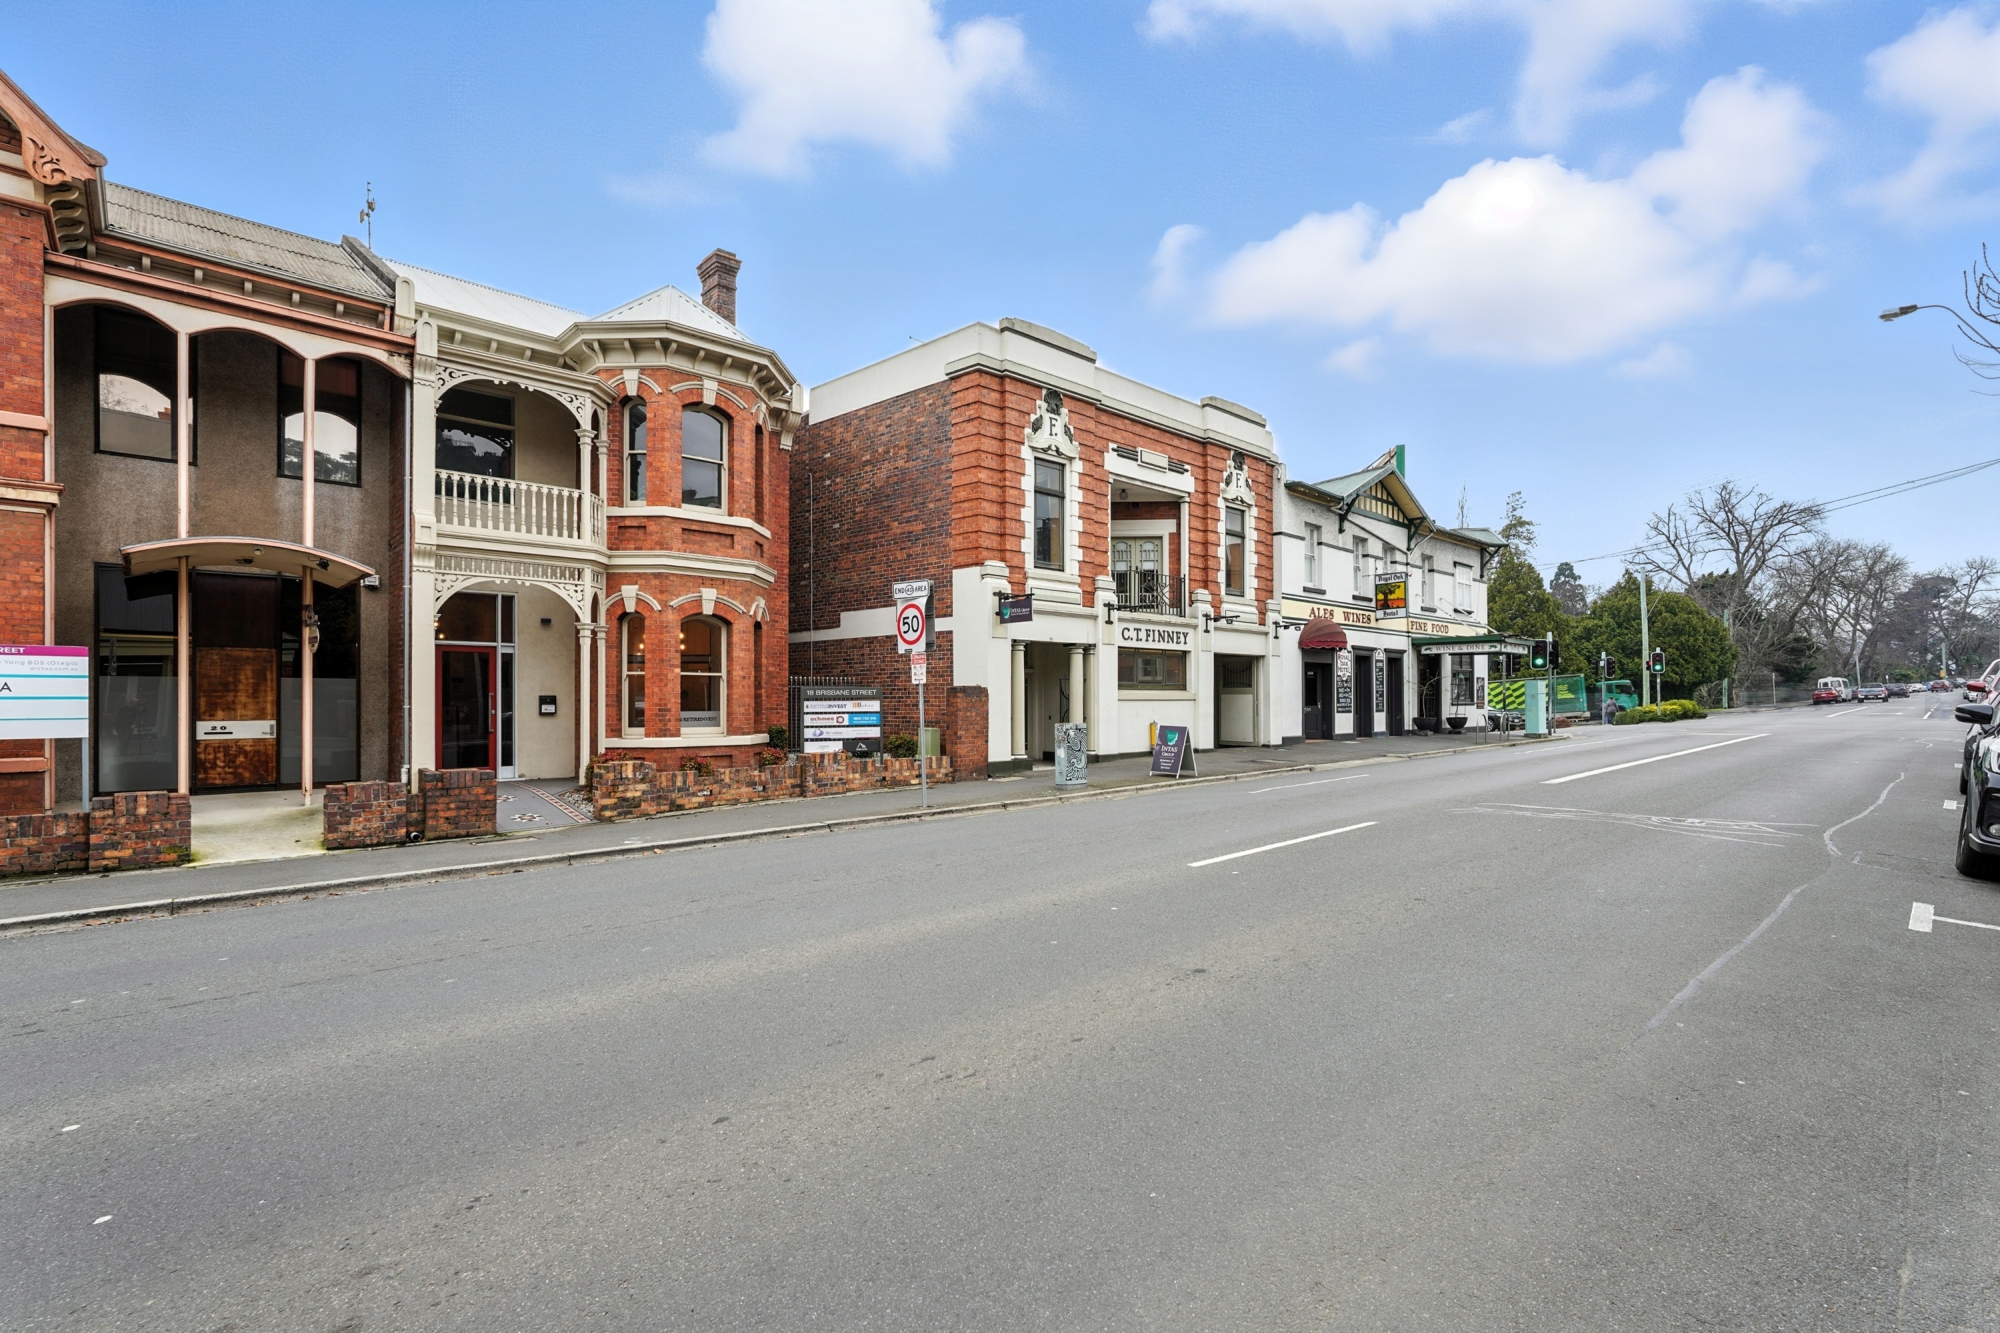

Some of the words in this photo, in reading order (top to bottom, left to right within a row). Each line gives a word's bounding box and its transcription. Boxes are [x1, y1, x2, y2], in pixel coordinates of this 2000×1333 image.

[895, 587, 904, 595] END
[1309, 606, 1334, 620] ALES
[1342, 611, 1372, 625] WINES
[902, 614, 920, 634] 50
[1410, 620, 1428, 632] FINE
[1431, 623, 1449, 634] FOOD
[1145, 628, 1189, 645] FINNEY
[1161, 745, 1178, 753] INTAS
